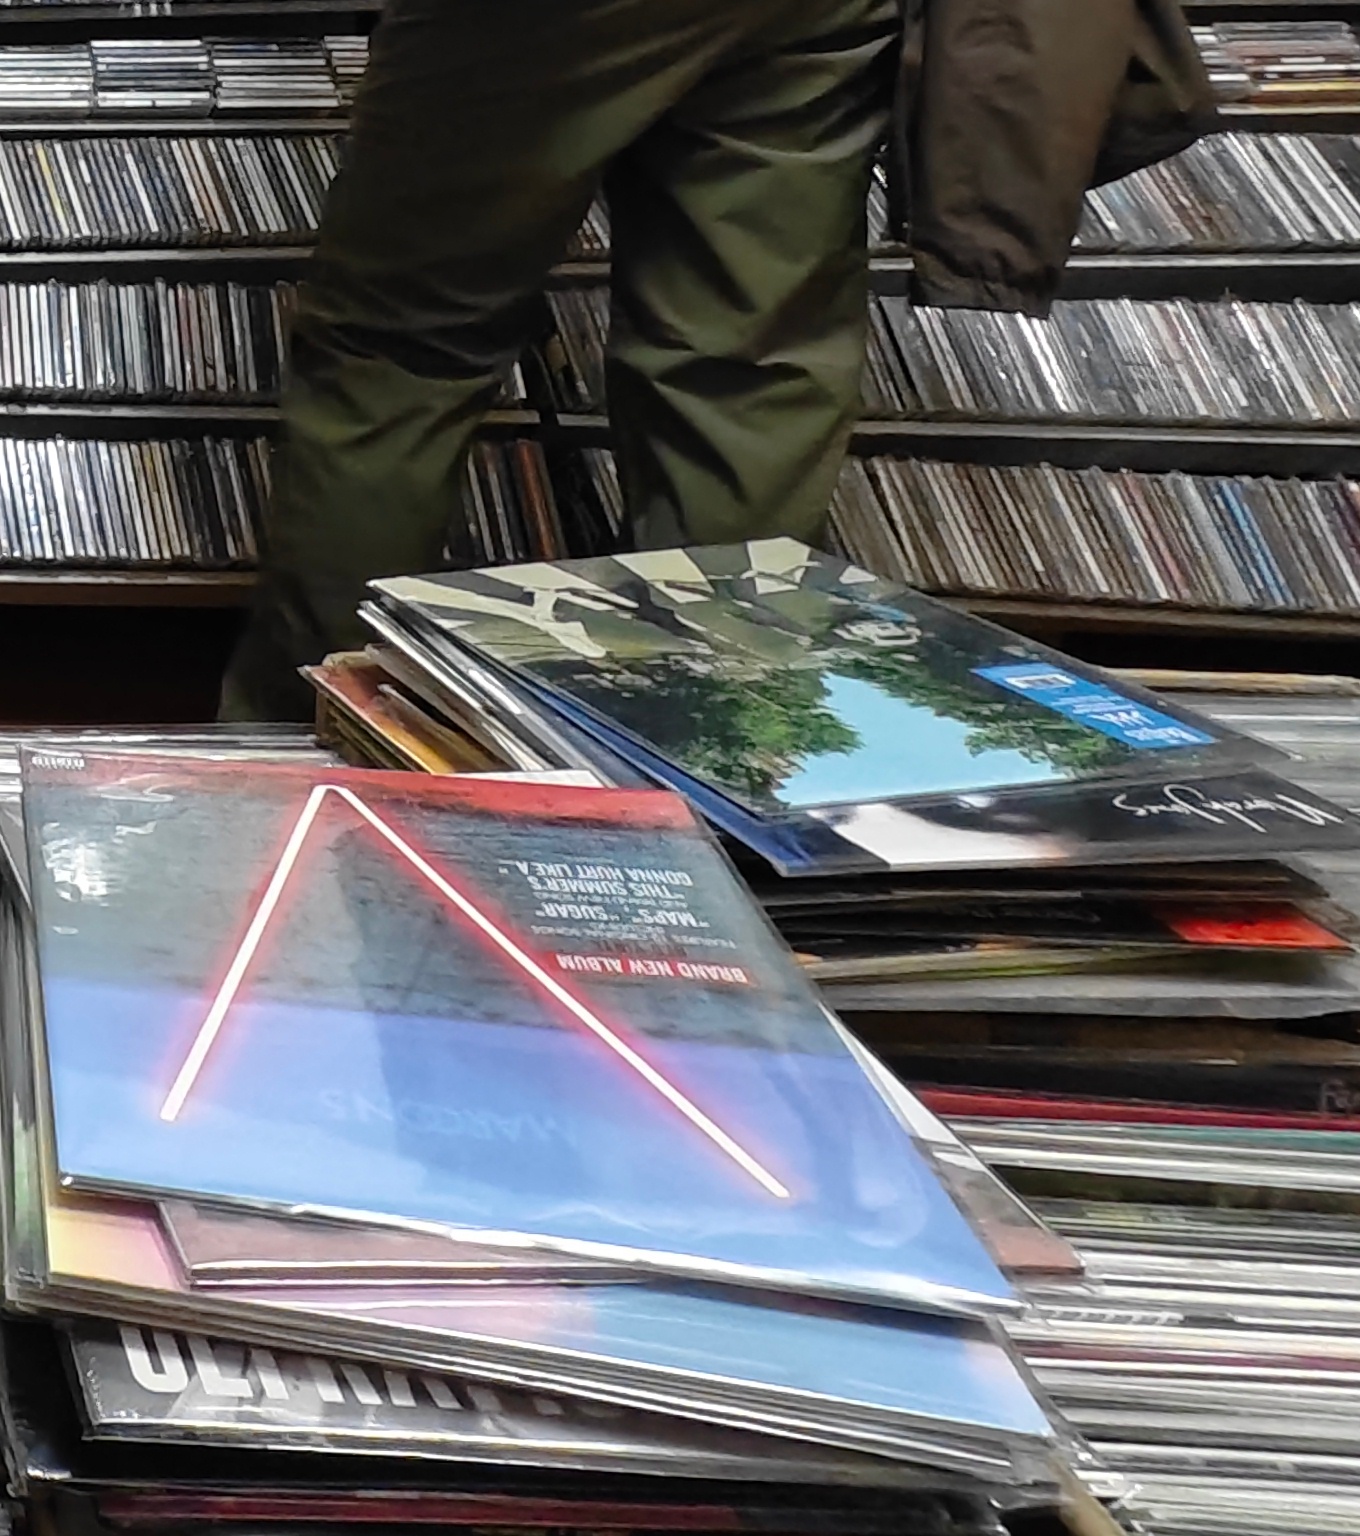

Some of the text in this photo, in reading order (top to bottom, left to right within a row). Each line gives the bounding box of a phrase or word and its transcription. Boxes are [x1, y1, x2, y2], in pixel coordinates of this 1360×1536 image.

[533, 861, 574, 879] LIKE
[578, 864, 624, 881] HURT
[628, 867, 694, 887] GONNA
[556, 953, 749, 984] BRAND NEW ALBUM
